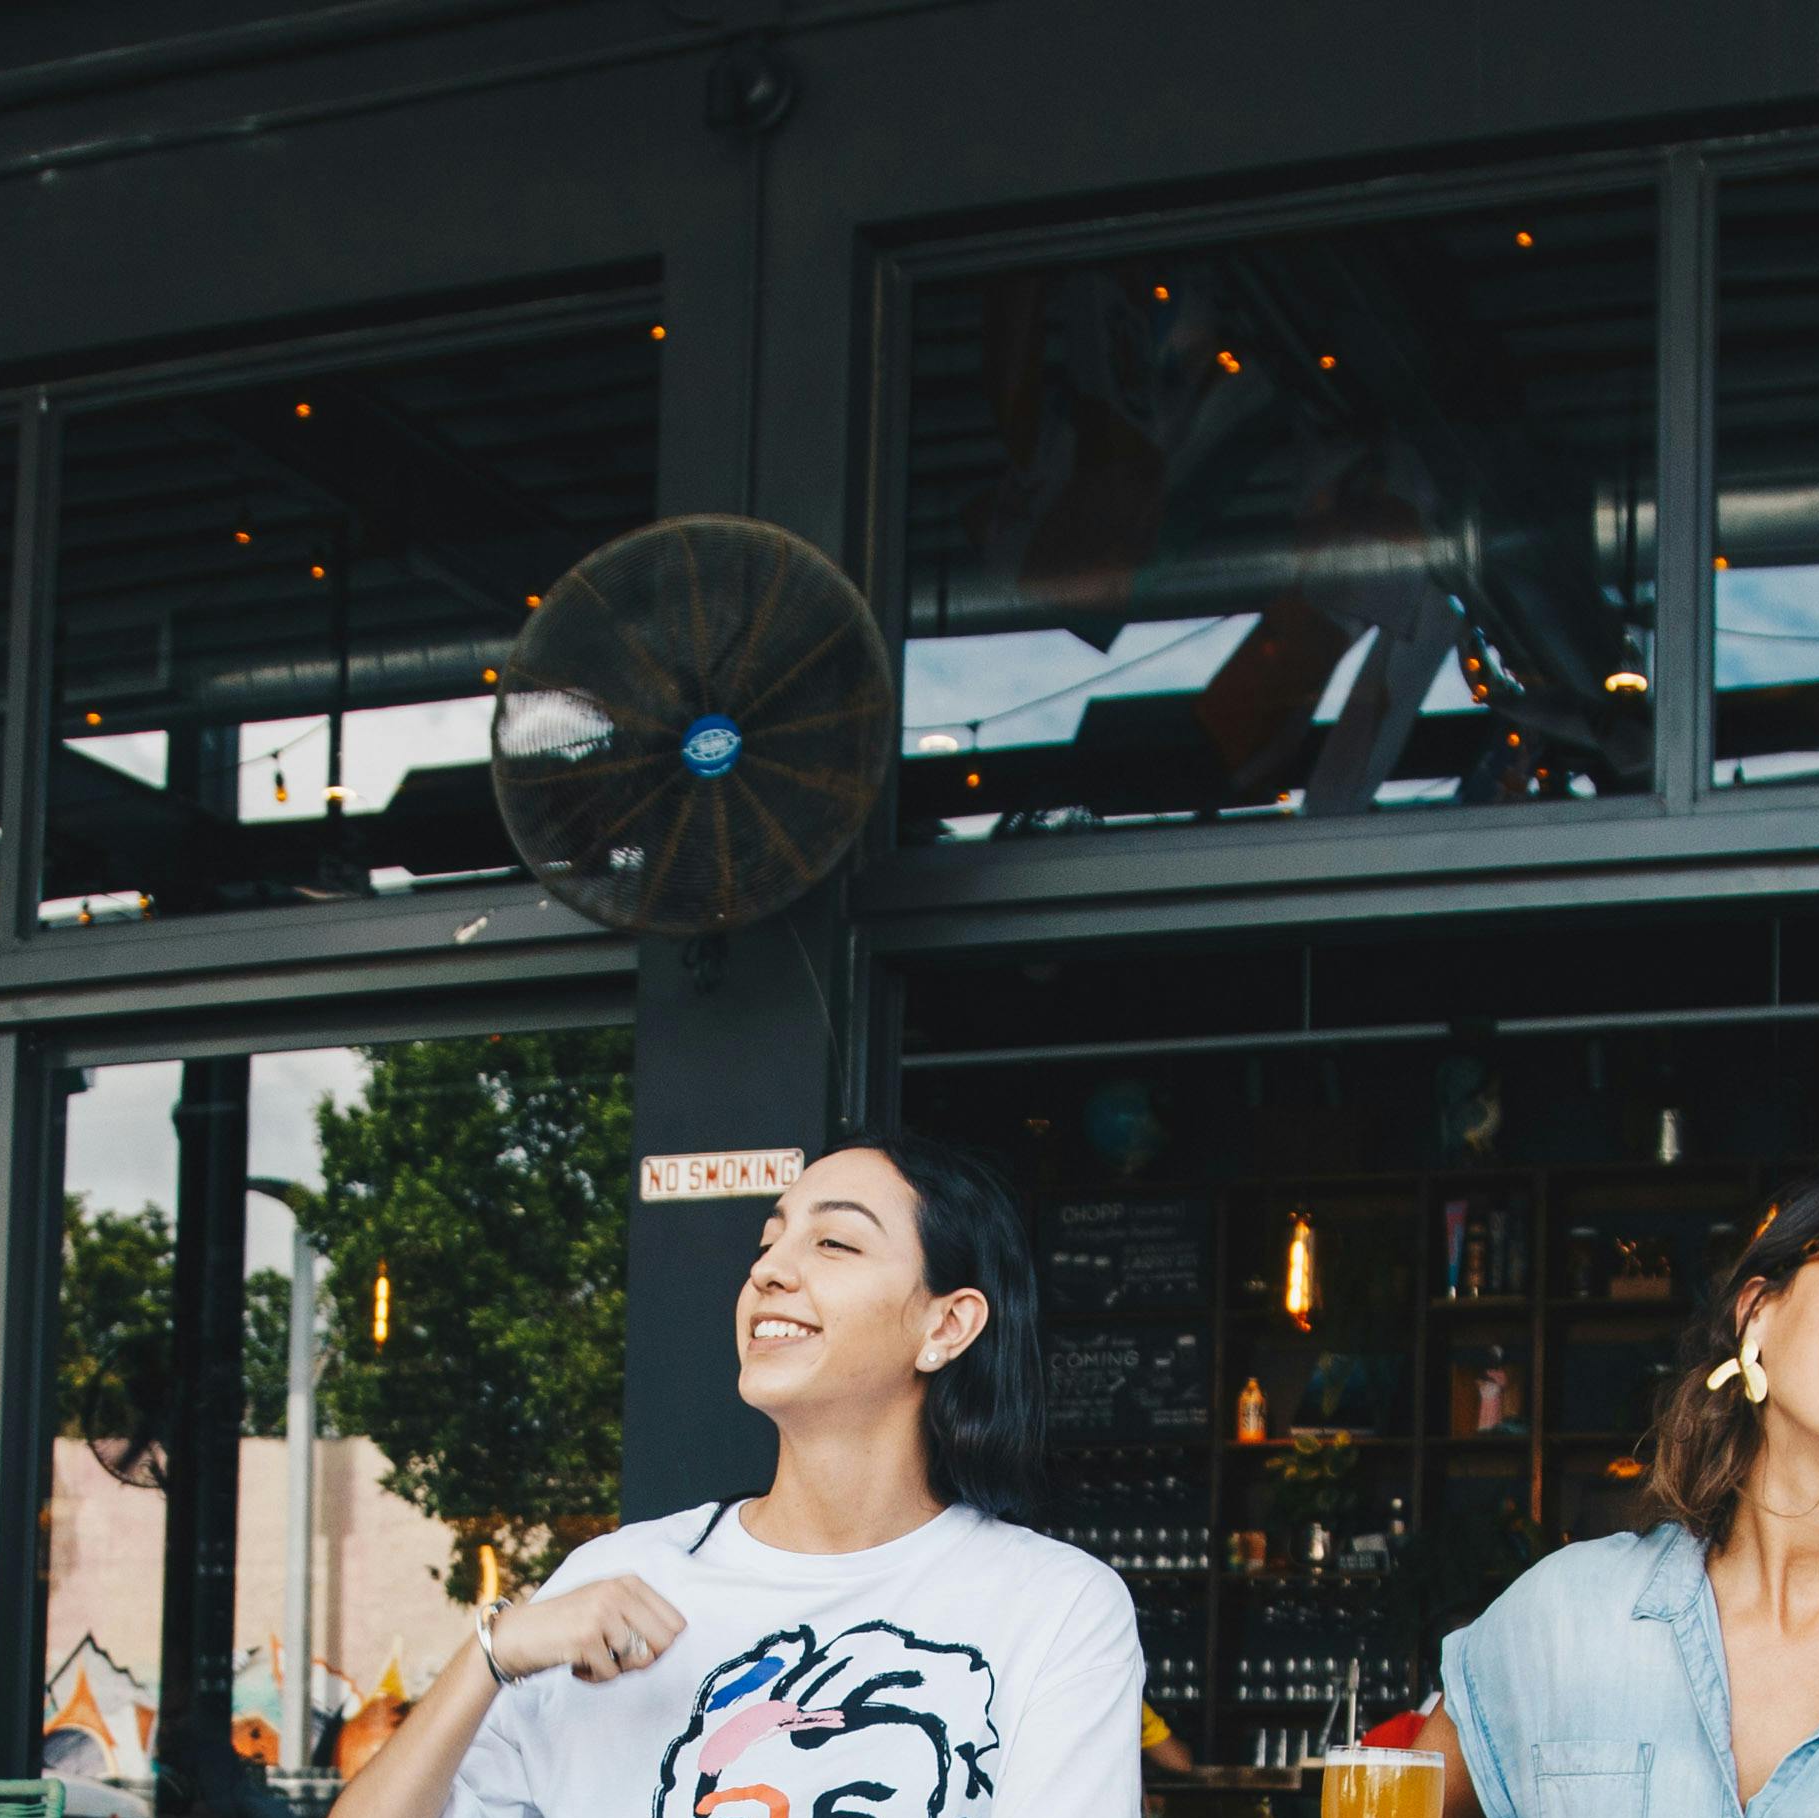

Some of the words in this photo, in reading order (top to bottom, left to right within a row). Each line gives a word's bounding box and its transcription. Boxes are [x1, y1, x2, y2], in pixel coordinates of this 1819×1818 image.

[649, 1163, 679, 1192] NO
[690, 1157, 796, 1190] SMOKING
[1050, 1350, 1140, 1369] COMING
